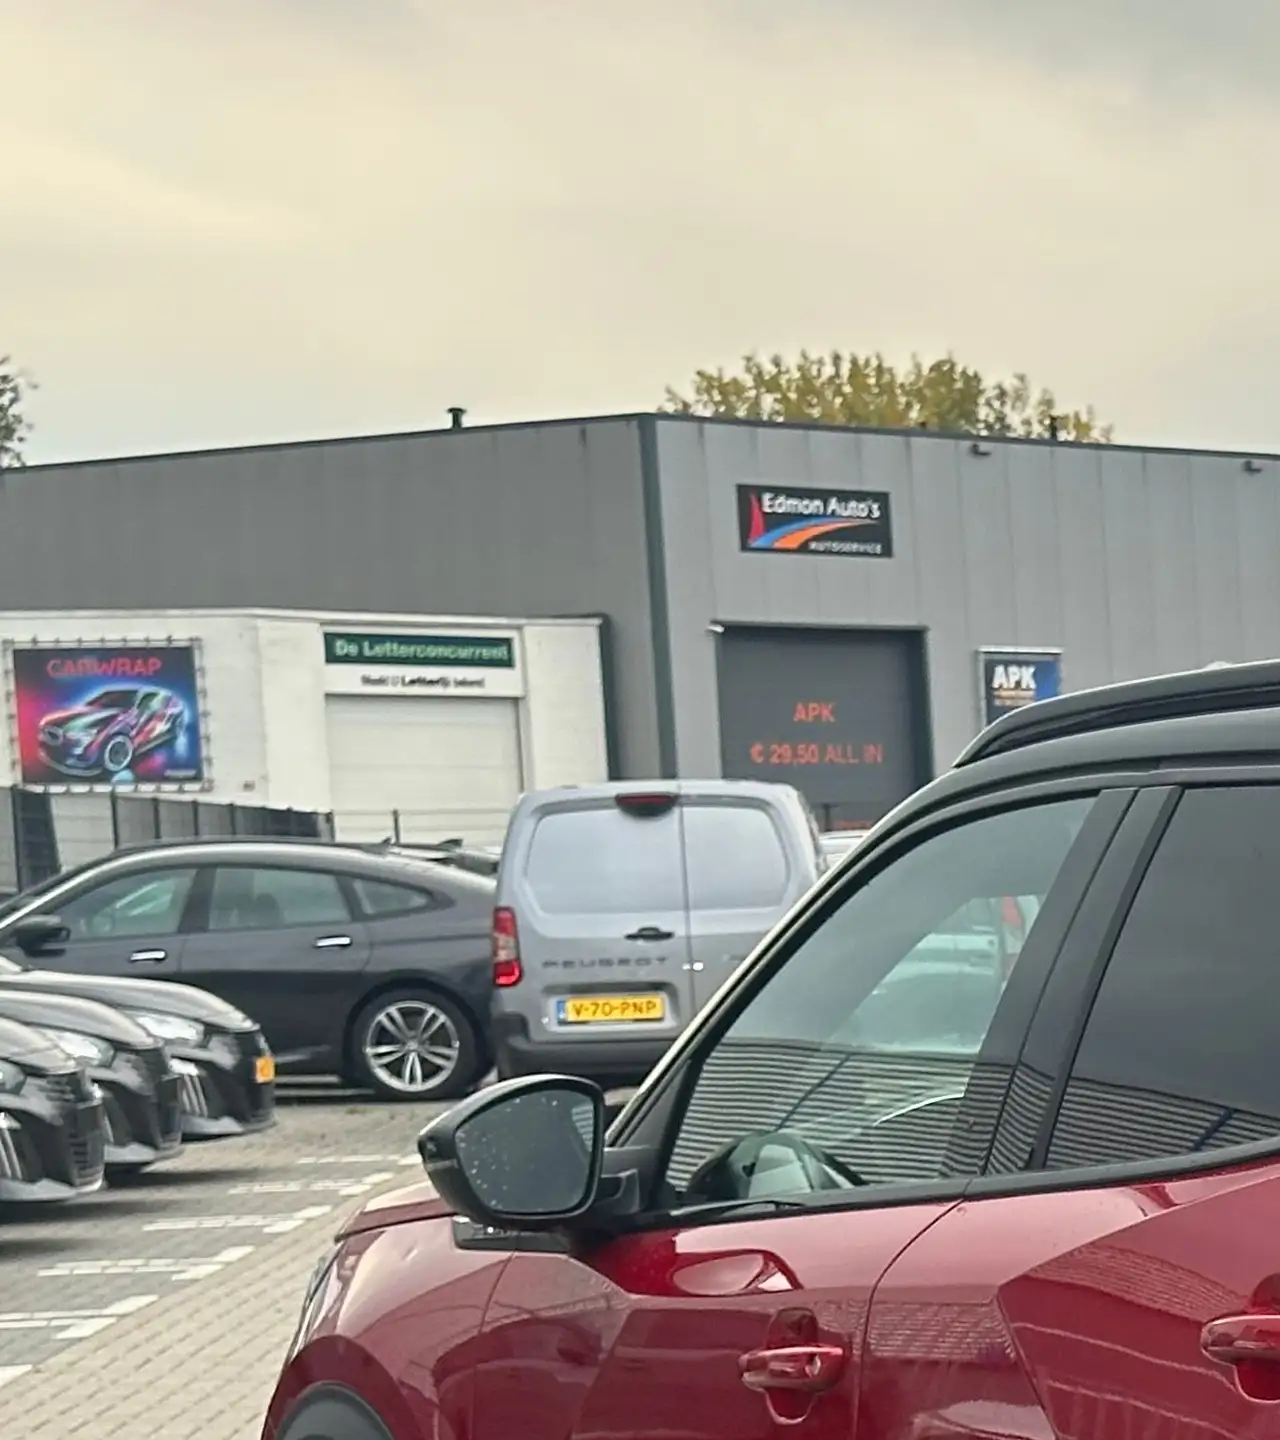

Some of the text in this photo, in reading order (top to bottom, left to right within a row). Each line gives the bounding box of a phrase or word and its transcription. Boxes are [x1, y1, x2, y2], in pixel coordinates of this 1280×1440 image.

[761, 493, 881, 518] Edmon Auto's
[334, 639, 358, 656] De
[46, 657, 162, 679] CARWRAP
[991, 665, 1036, 689] APK
[793, 703, 835, 723] APK
[750, 744, 764, 763] €
[825, 744, 859, 764] ALL
